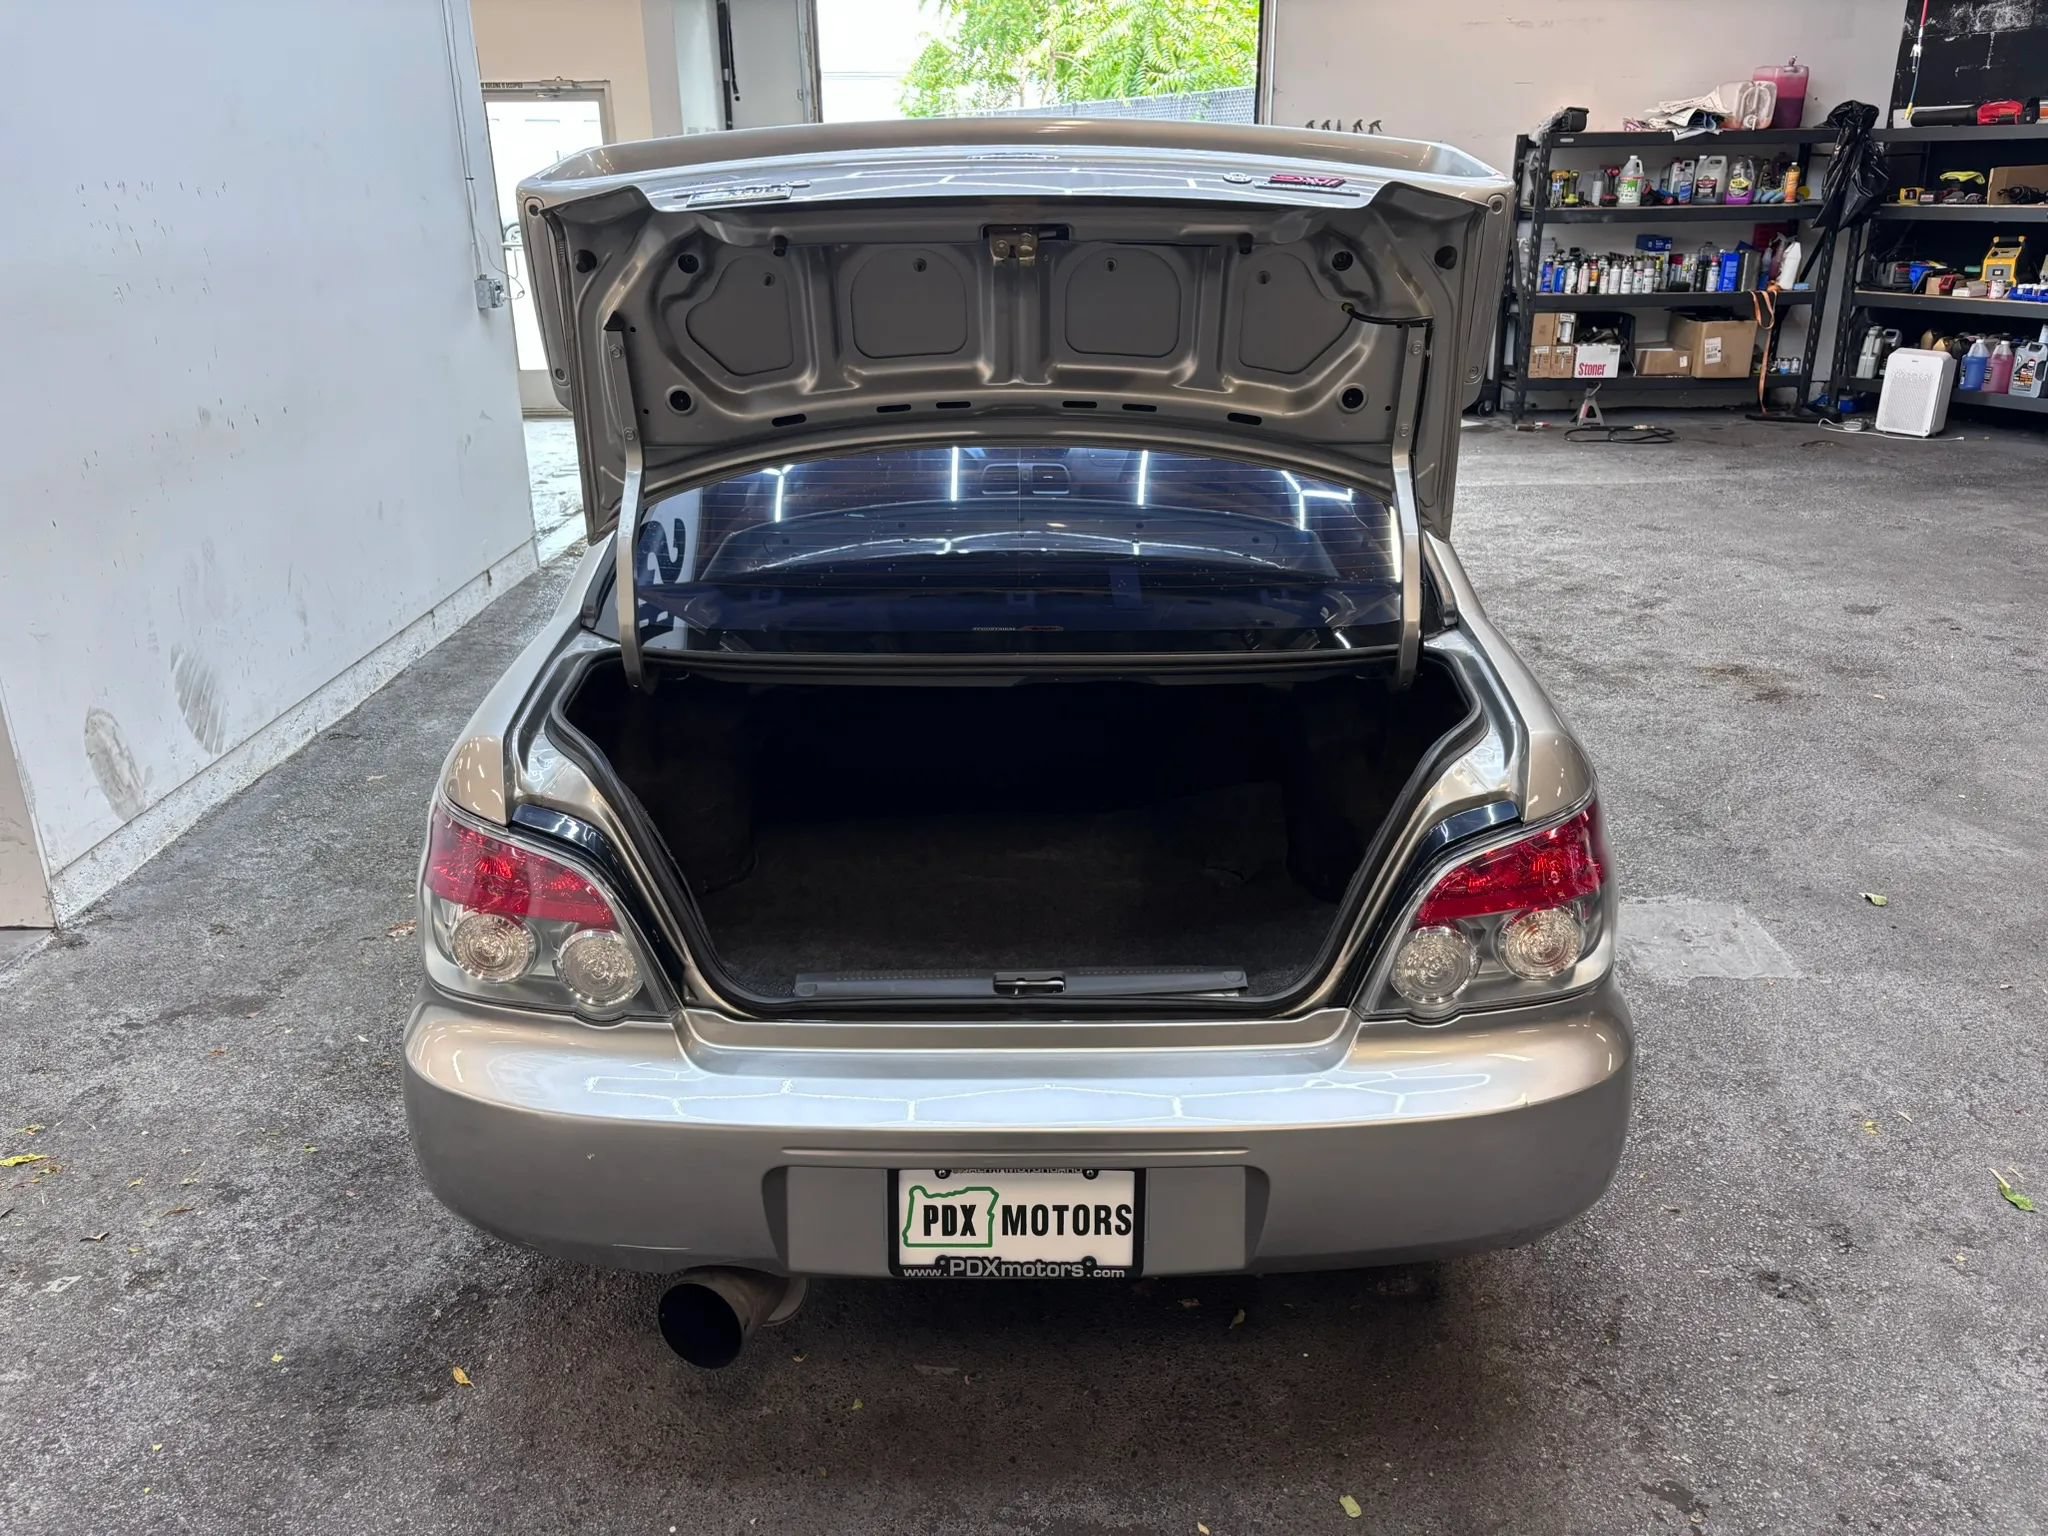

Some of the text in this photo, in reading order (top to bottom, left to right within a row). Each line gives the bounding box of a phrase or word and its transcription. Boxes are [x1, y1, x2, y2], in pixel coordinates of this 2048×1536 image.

[1578, 362, 1606, 376] Stoner
[922, 1203, 1132, 1236] PDX MOTORS
[903, 1259, 1125, 1278] www.PDXmotors.com
